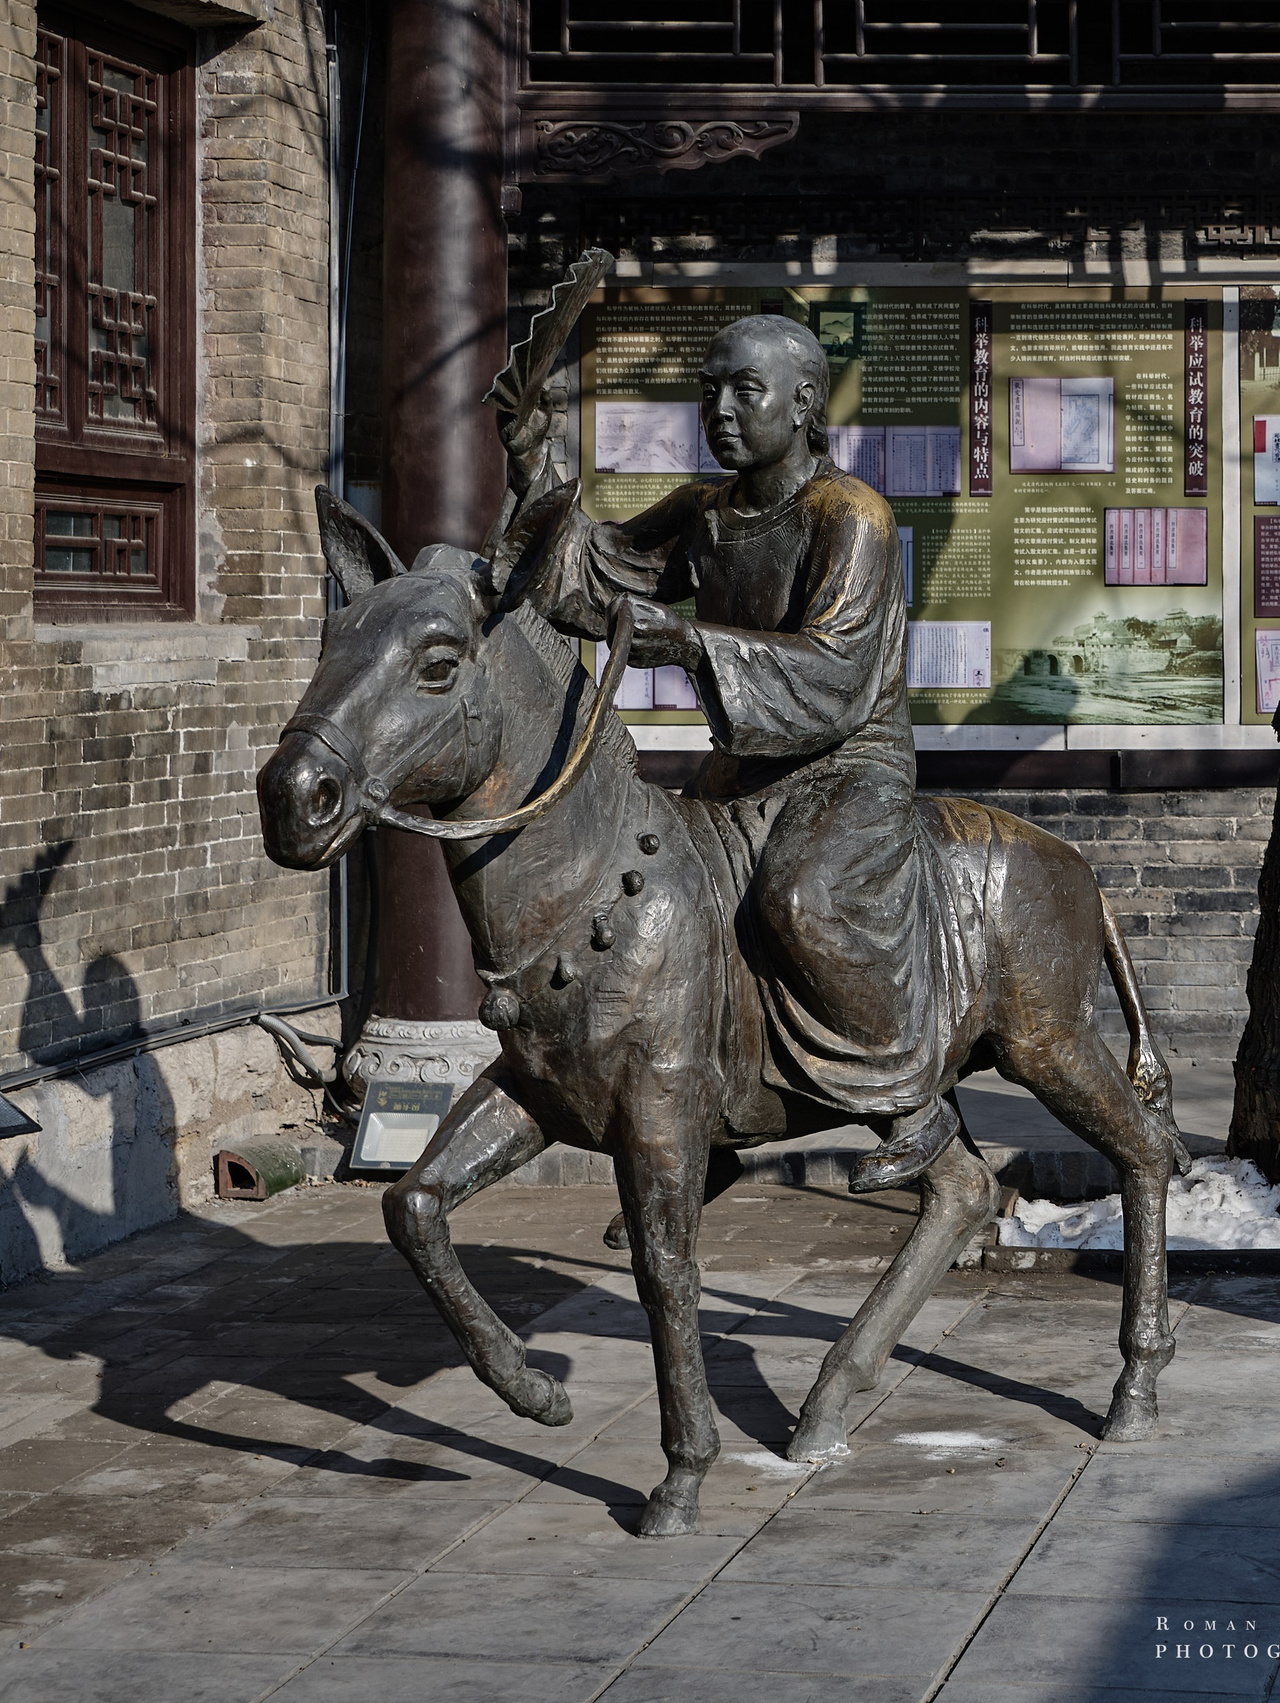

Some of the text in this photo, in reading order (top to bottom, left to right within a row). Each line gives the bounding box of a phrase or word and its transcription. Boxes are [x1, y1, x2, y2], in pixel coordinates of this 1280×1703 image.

[973, 316, 990, 479] 科举教育的内容与特点
[1188, 317, 1204, 477] 科举应试教育的突破
